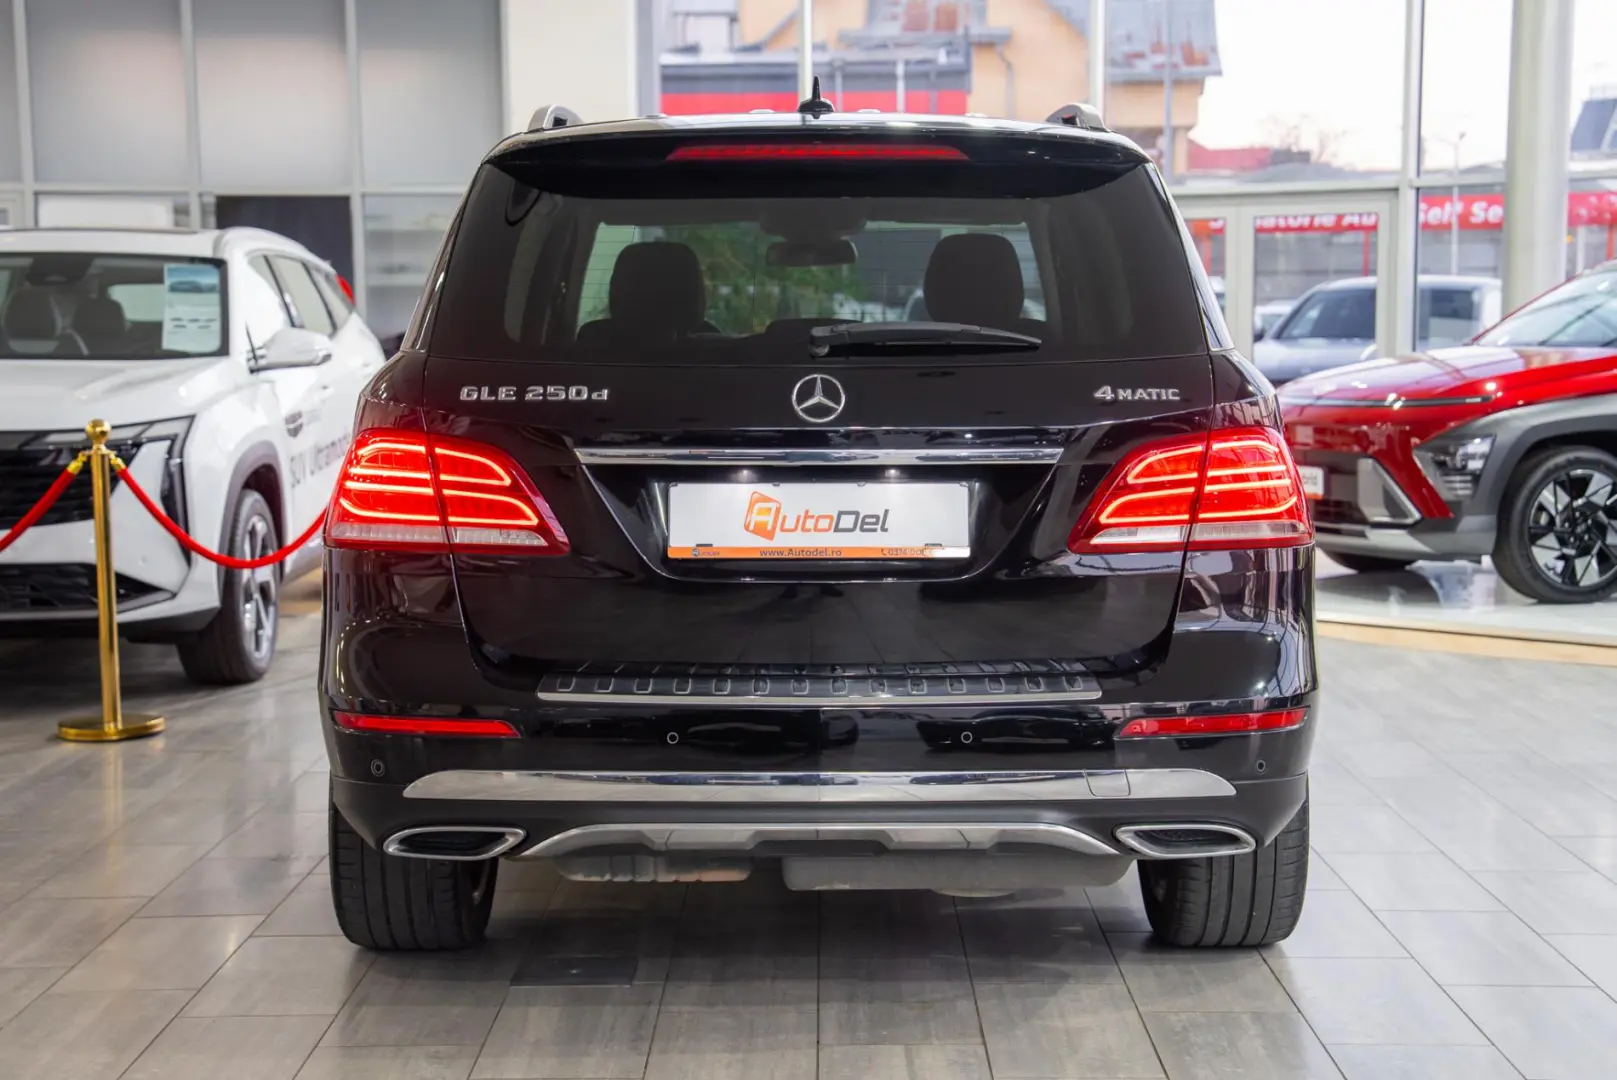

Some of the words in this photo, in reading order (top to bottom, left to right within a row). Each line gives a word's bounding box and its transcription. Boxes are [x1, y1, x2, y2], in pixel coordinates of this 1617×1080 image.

[1469, 200, 1504, 224] Se
[459, 385, 517, 401] GLE
[524, 385, 609, 401] 250d
[747, 499, 890, 534] AutoDel
[759, 548, 842, 557] www.Autodel.ro
